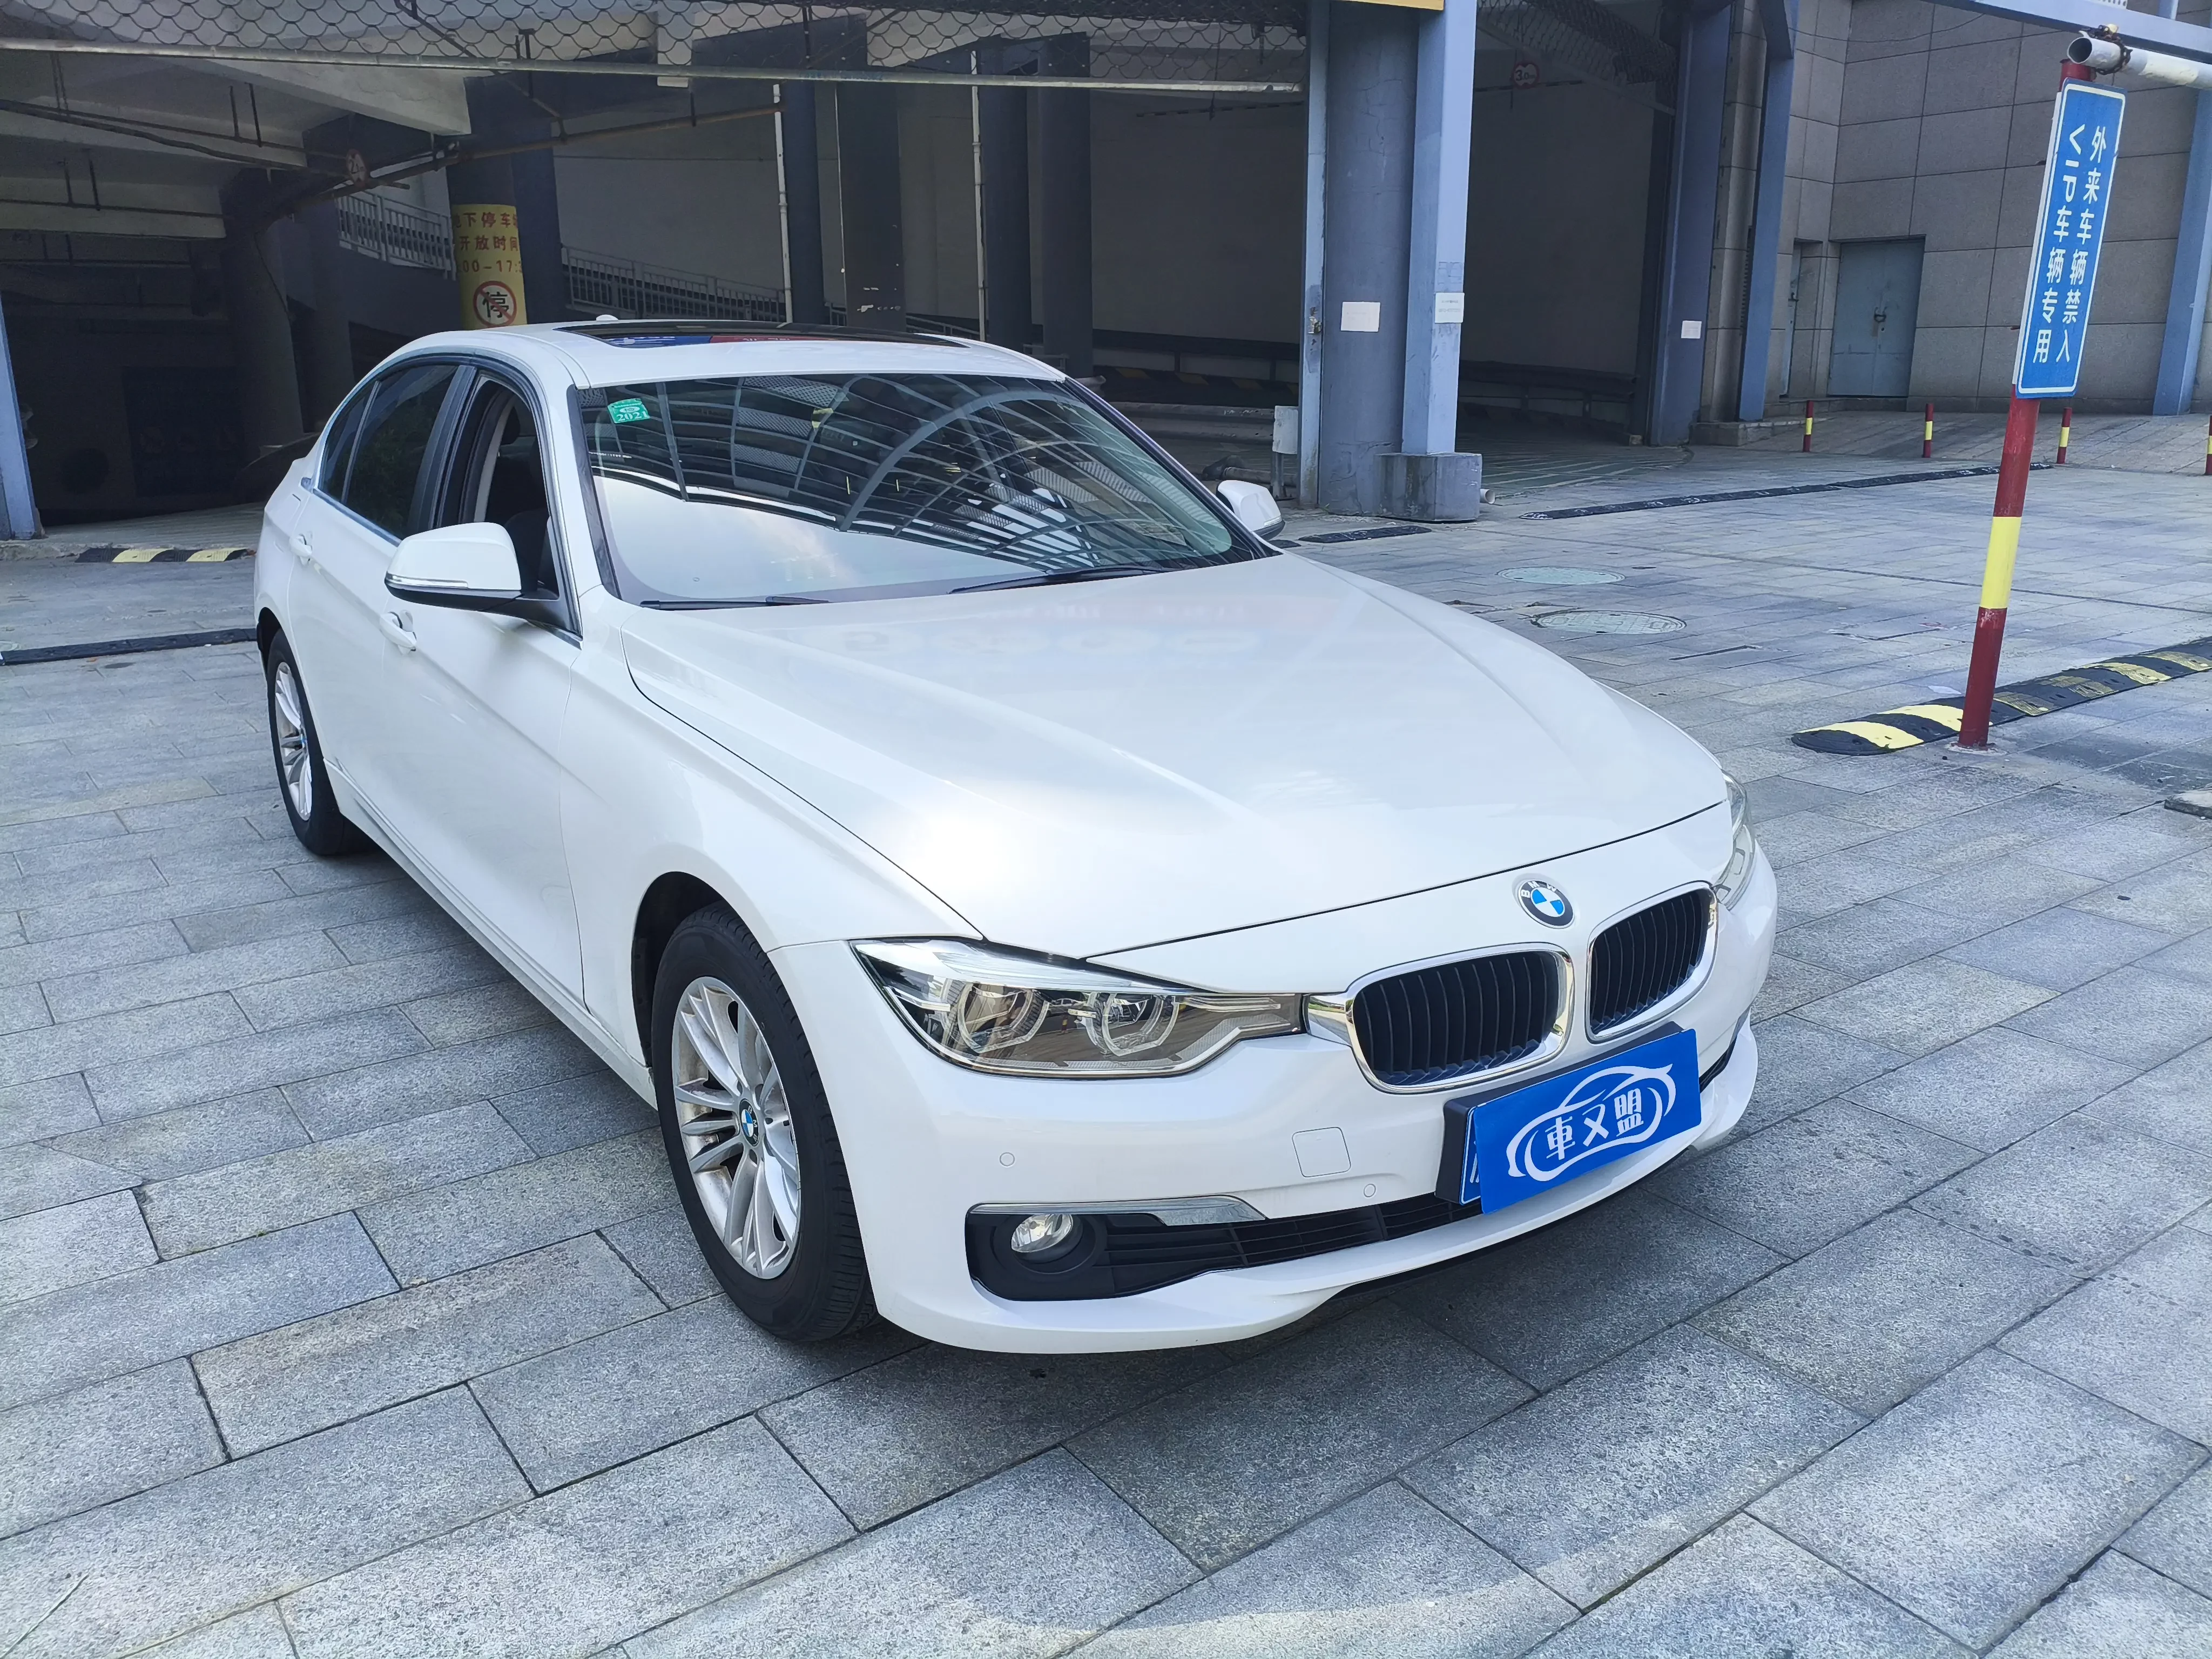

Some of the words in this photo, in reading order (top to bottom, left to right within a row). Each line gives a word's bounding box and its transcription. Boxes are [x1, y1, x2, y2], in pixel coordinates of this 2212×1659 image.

[2056, 126, 2107, 362] 外来车辆禁入
[616, 410, 649, 422] 2021
[1521, 881, 1557, 898] BMW
[748, 1105, 758, 1142] BMW
